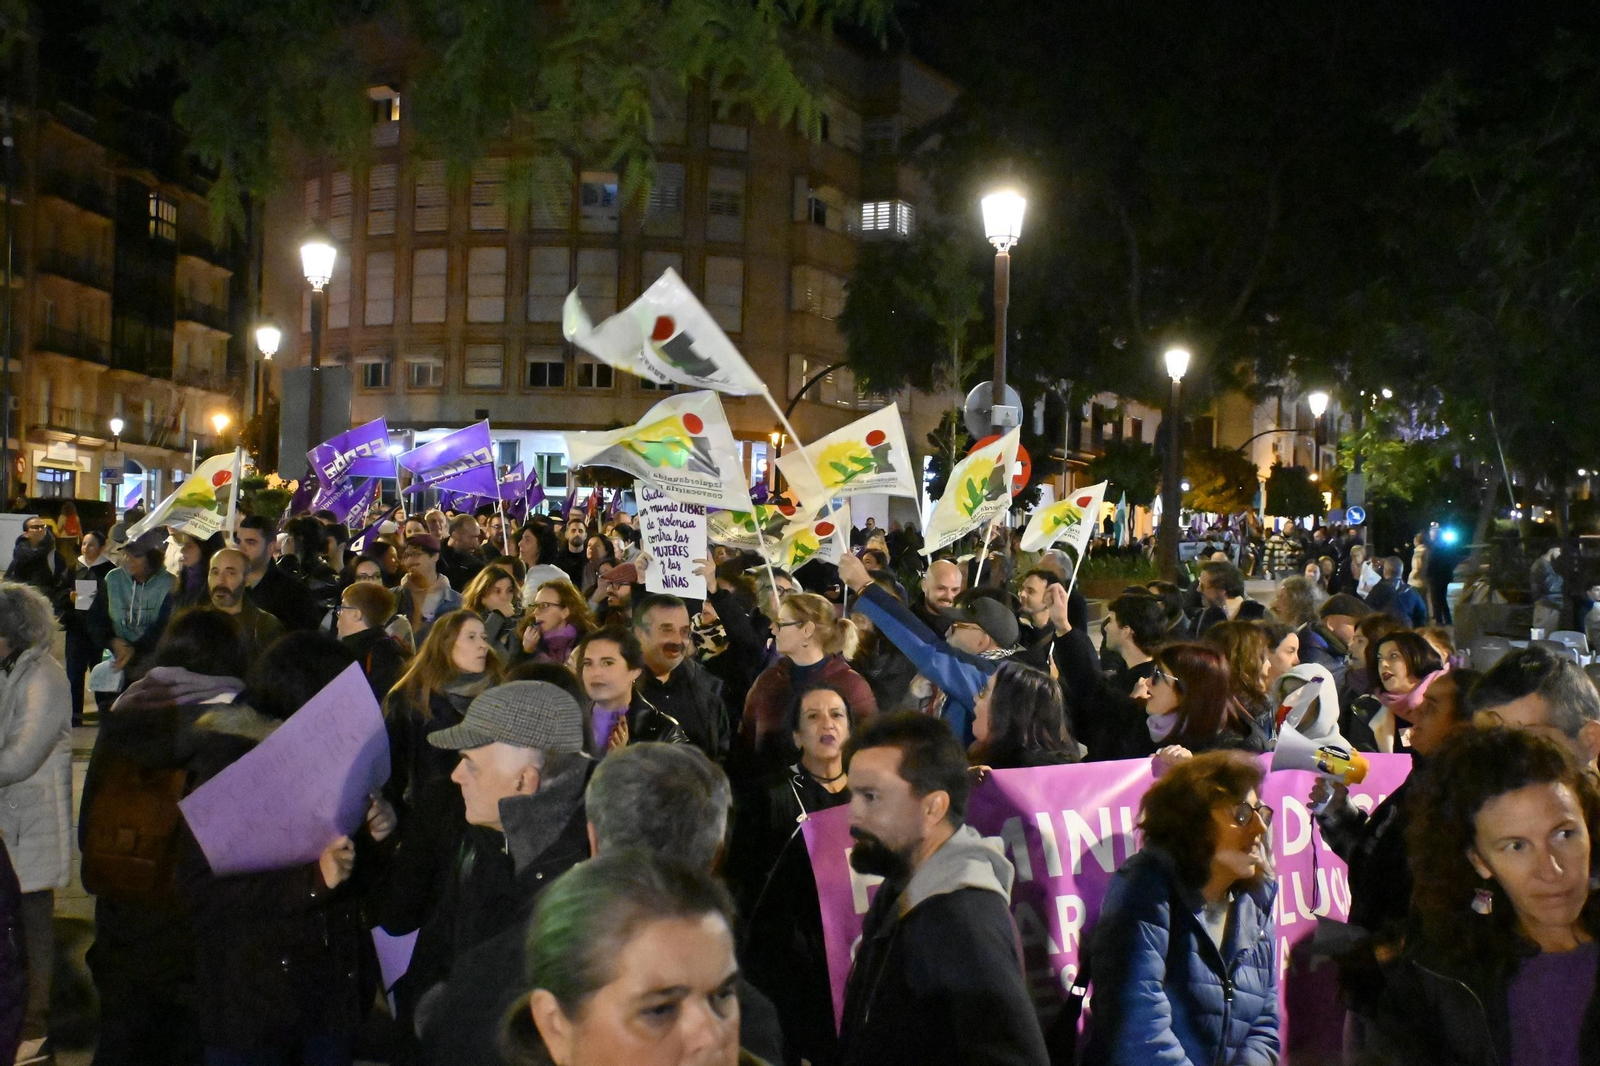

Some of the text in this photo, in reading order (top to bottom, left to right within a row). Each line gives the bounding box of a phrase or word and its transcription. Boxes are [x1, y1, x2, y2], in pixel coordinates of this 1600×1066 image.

[639, 502, 705, 517] un mundo LIBRE
[647, 517, 655, 530] de
[656, 513, 696, 529] violencia
[647, 527, 690, 544] contra las
[652, 544, 689, 558] MUJERES
[659, 557, 681, 575] y las
